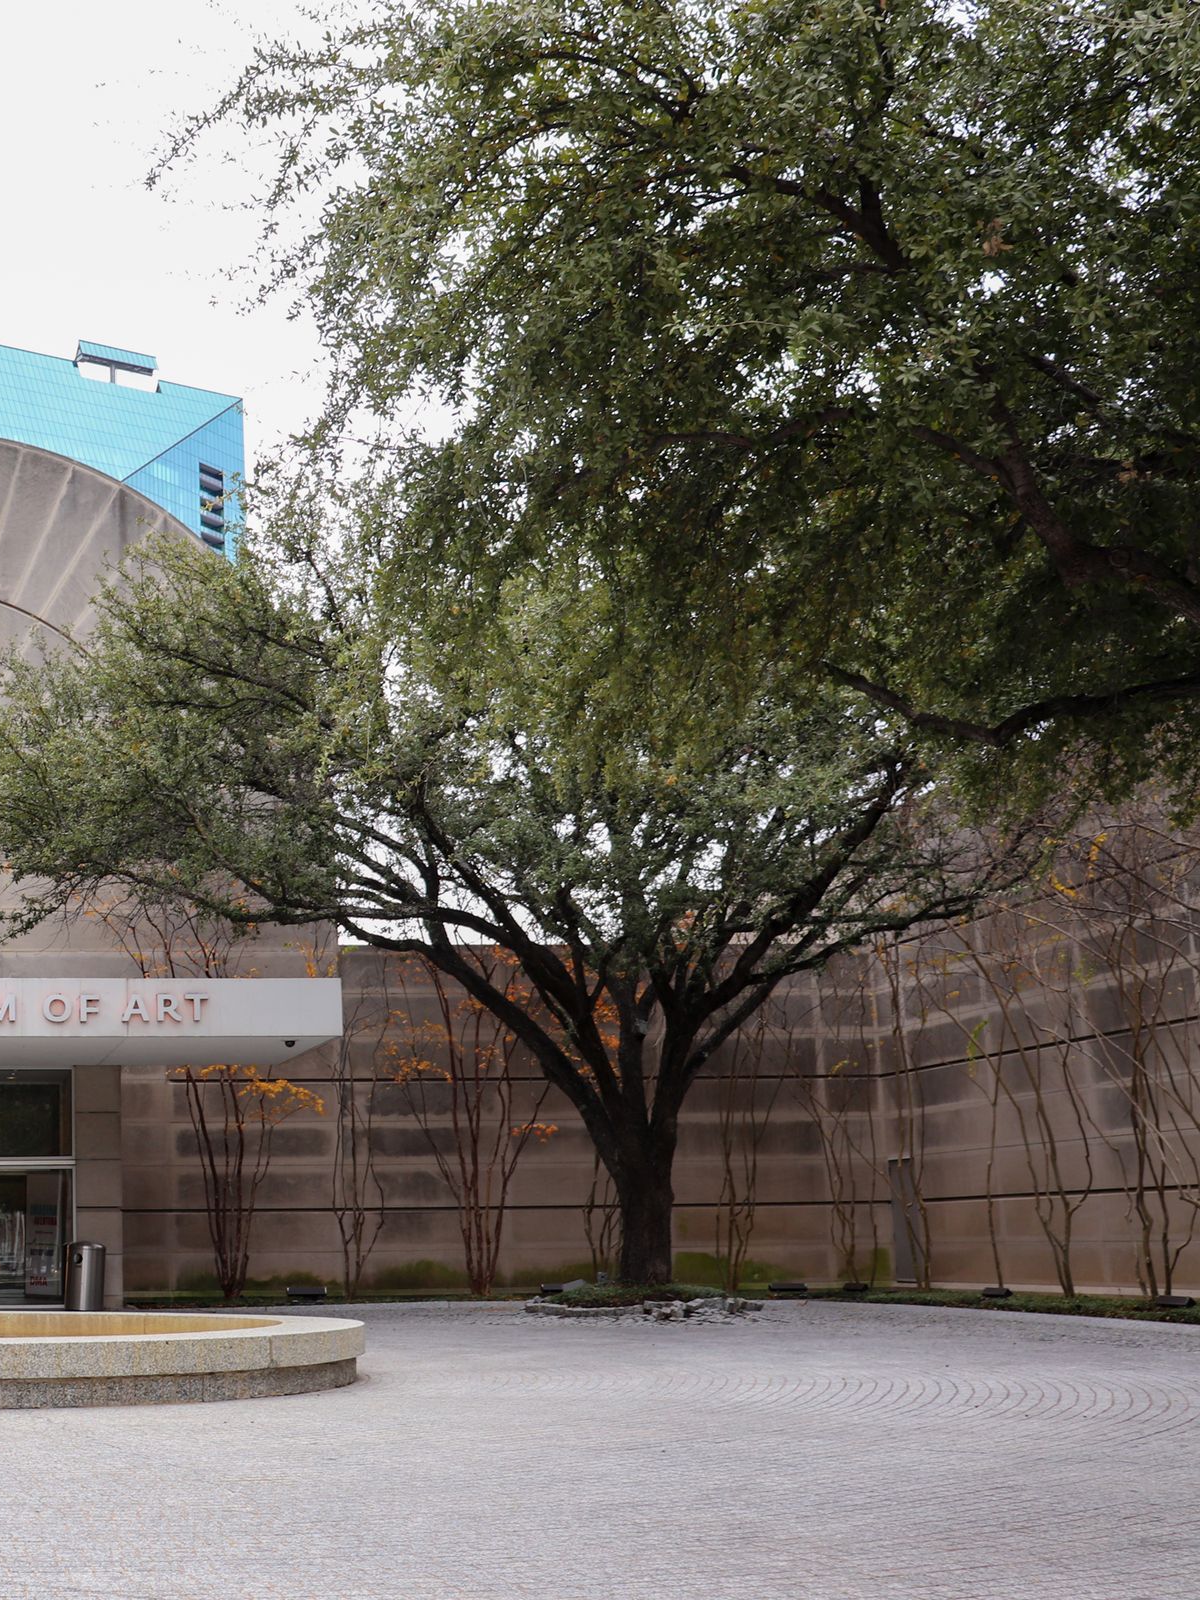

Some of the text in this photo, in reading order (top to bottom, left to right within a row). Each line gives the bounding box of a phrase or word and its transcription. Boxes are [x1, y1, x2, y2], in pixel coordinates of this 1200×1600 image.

[43, 993, 100, 1023] OF
[121, 993, 209, 1023] ART
[30, 1276, 48, 1287] DMA
